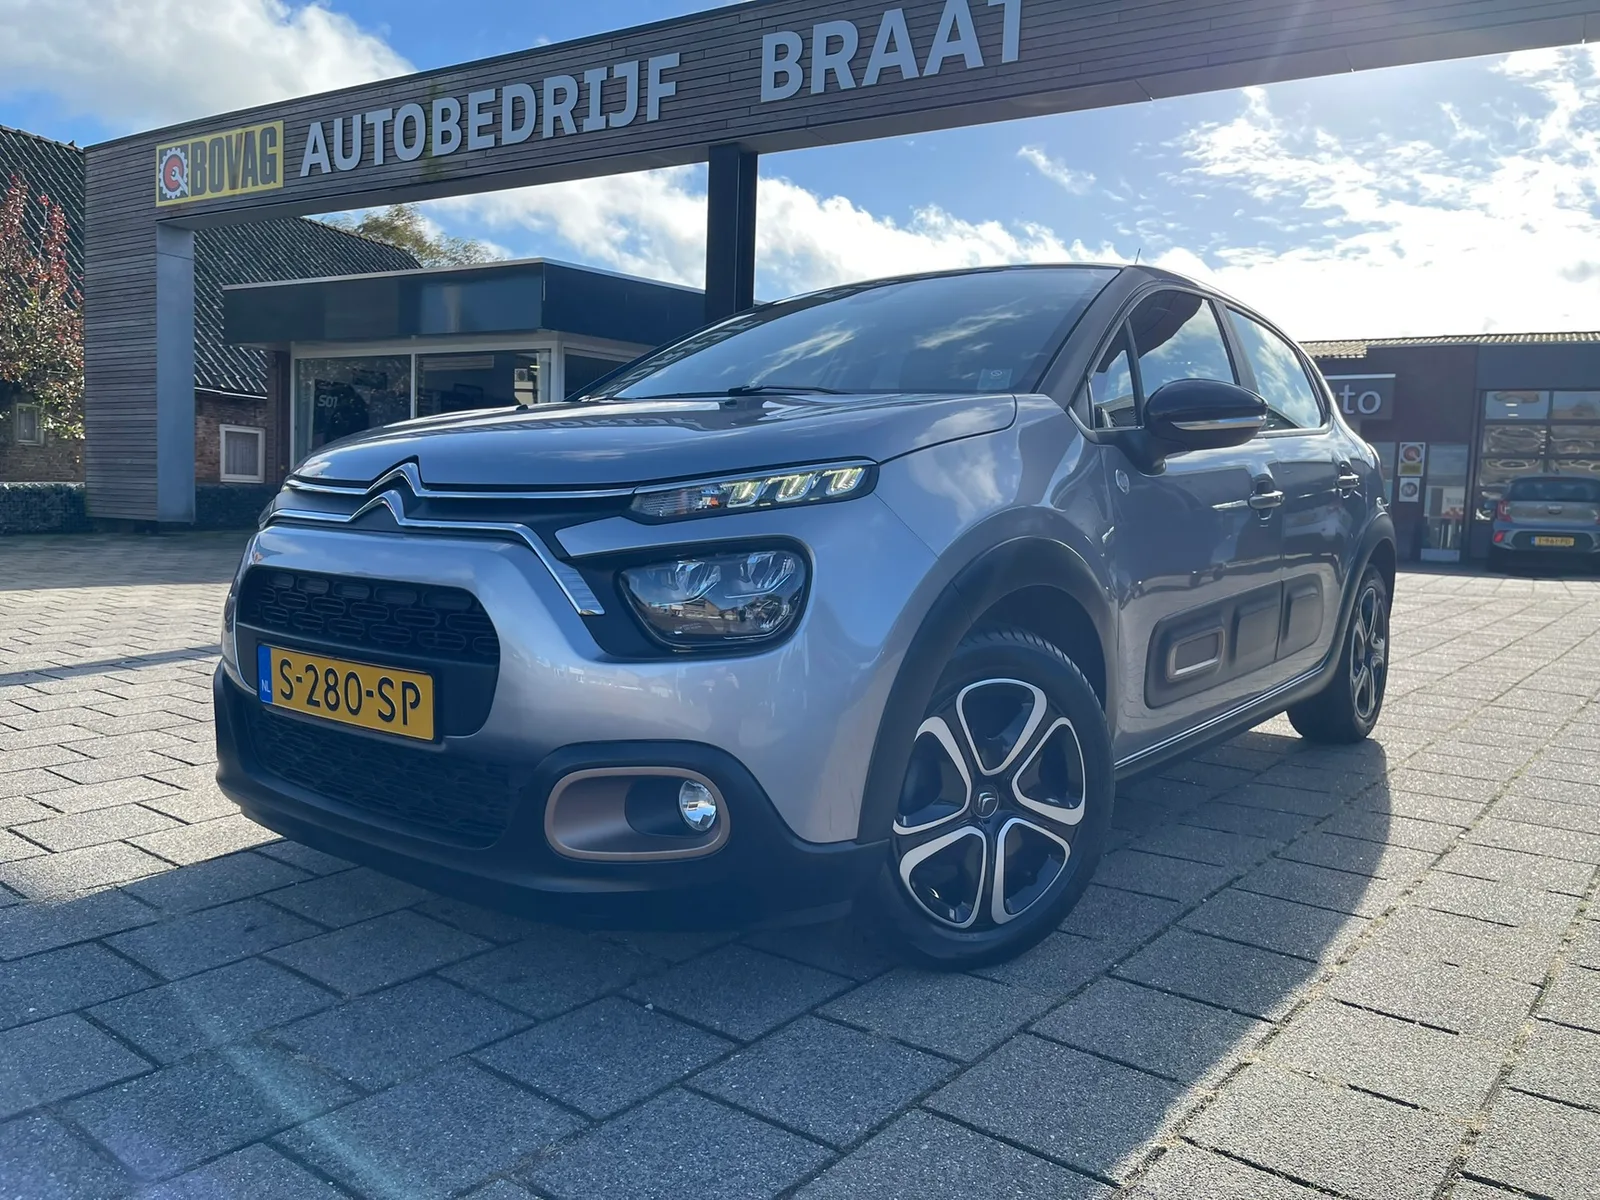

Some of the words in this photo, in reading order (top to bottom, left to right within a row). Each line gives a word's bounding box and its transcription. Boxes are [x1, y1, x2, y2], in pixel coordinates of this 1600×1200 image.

[300, 52, 681, 178] AUTOBEDRIJF
[760, 0, 1022, 103] BRAAT
[190, 126, 278, 193] BOVAG
[1332, 384, 1382, 415] to
[261, 679, 271, 694] NL
[279, 658, 421, 726] S-280-SP
